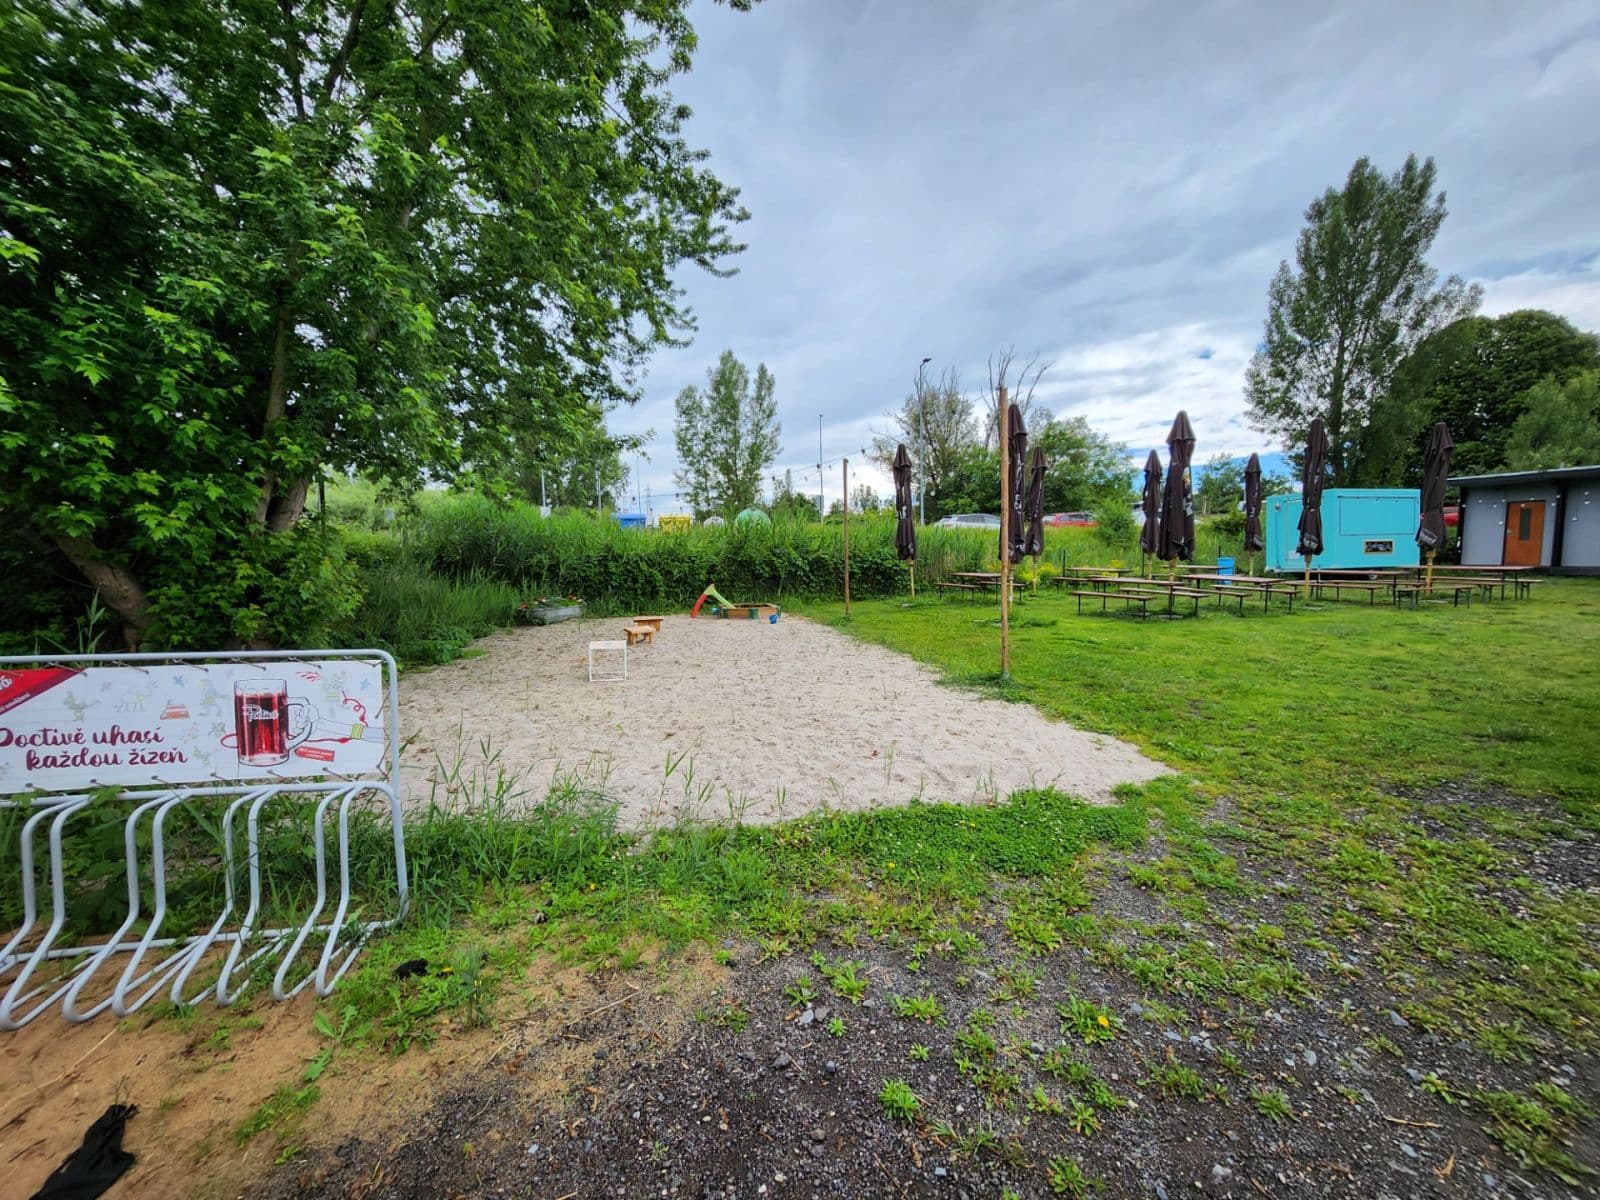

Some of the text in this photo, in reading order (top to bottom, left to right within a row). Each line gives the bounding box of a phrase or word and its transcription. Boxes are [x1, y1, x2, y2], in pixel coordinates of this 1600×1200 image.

[92, 724, 164, 746] uhasí
[26, 747, 187, 770] každou žízeň
